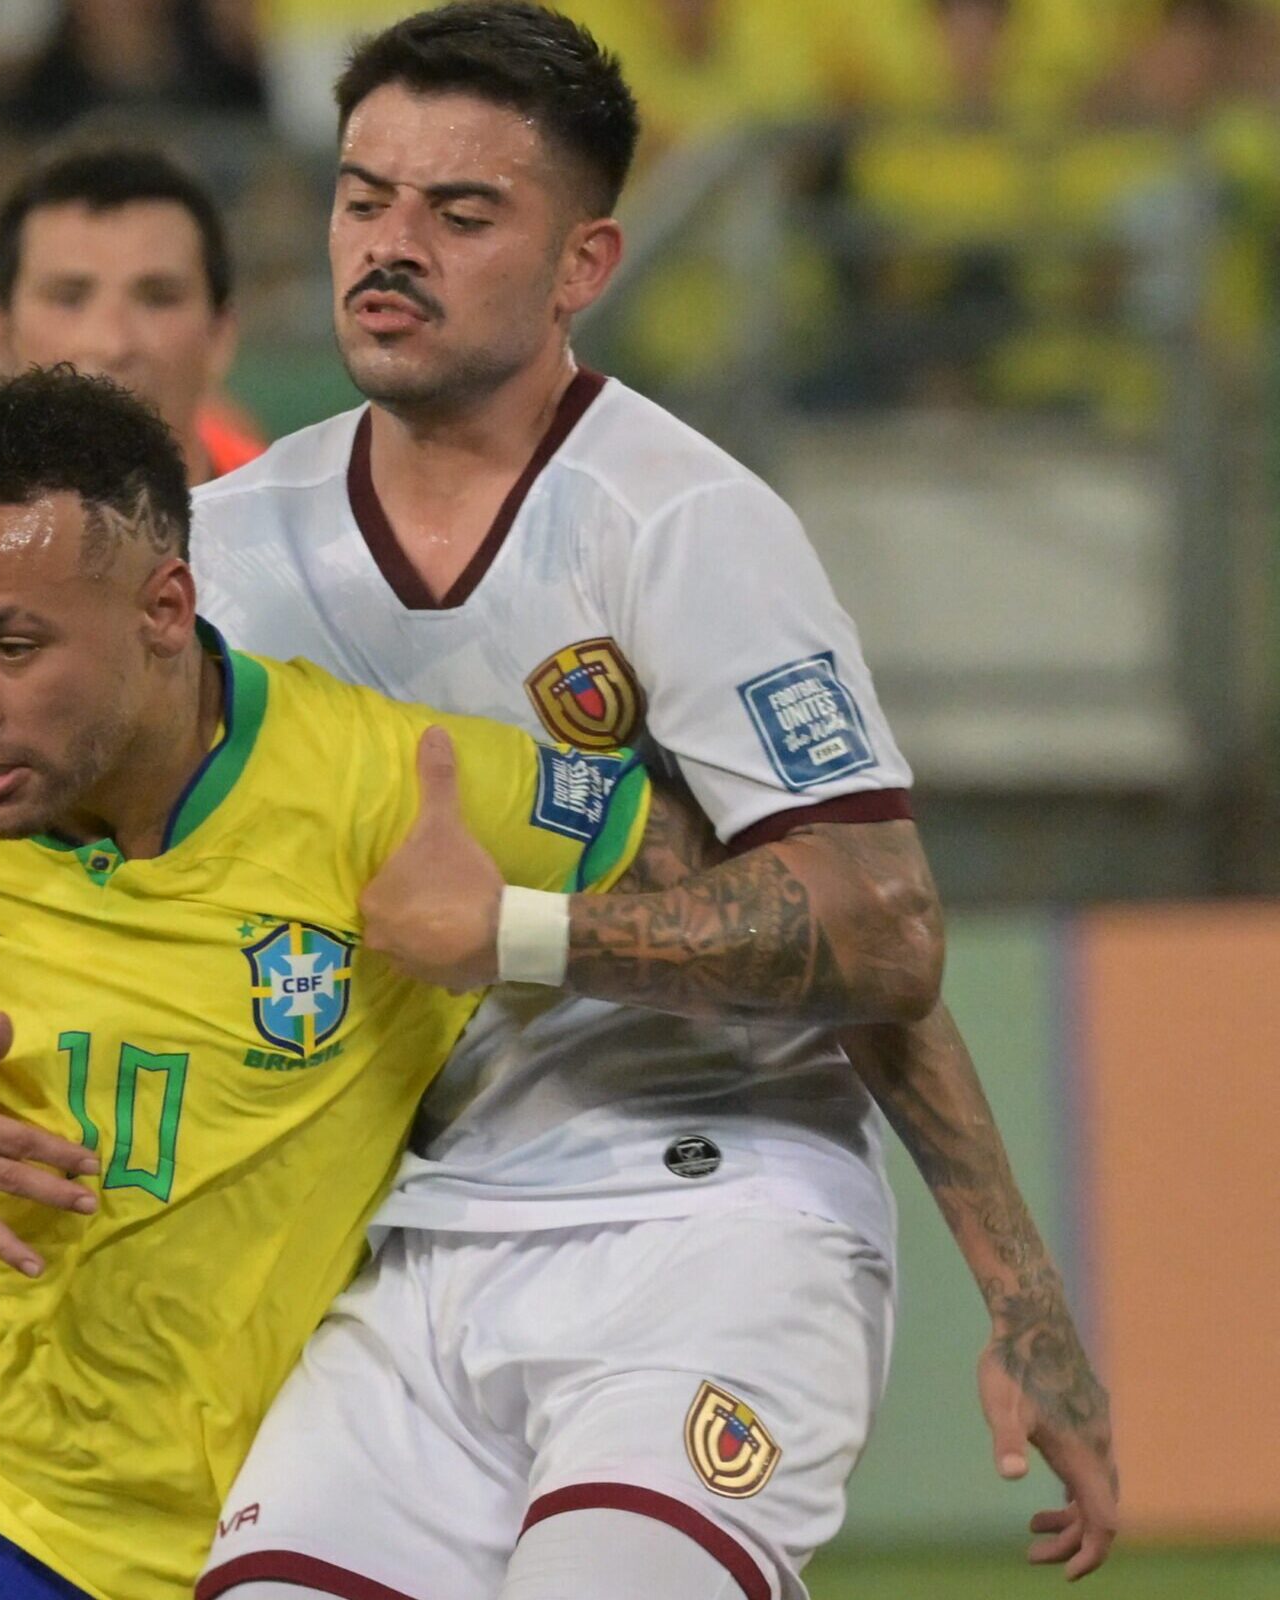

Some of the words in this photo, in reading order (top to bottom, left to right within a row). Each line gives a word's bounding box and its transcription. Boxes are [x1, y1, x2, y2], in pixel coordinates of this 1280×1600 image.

[777, 692, 838, 731] UNITES
[282, 975, 323, 994] CBF
[57, 1030, 190, 1204] 10
